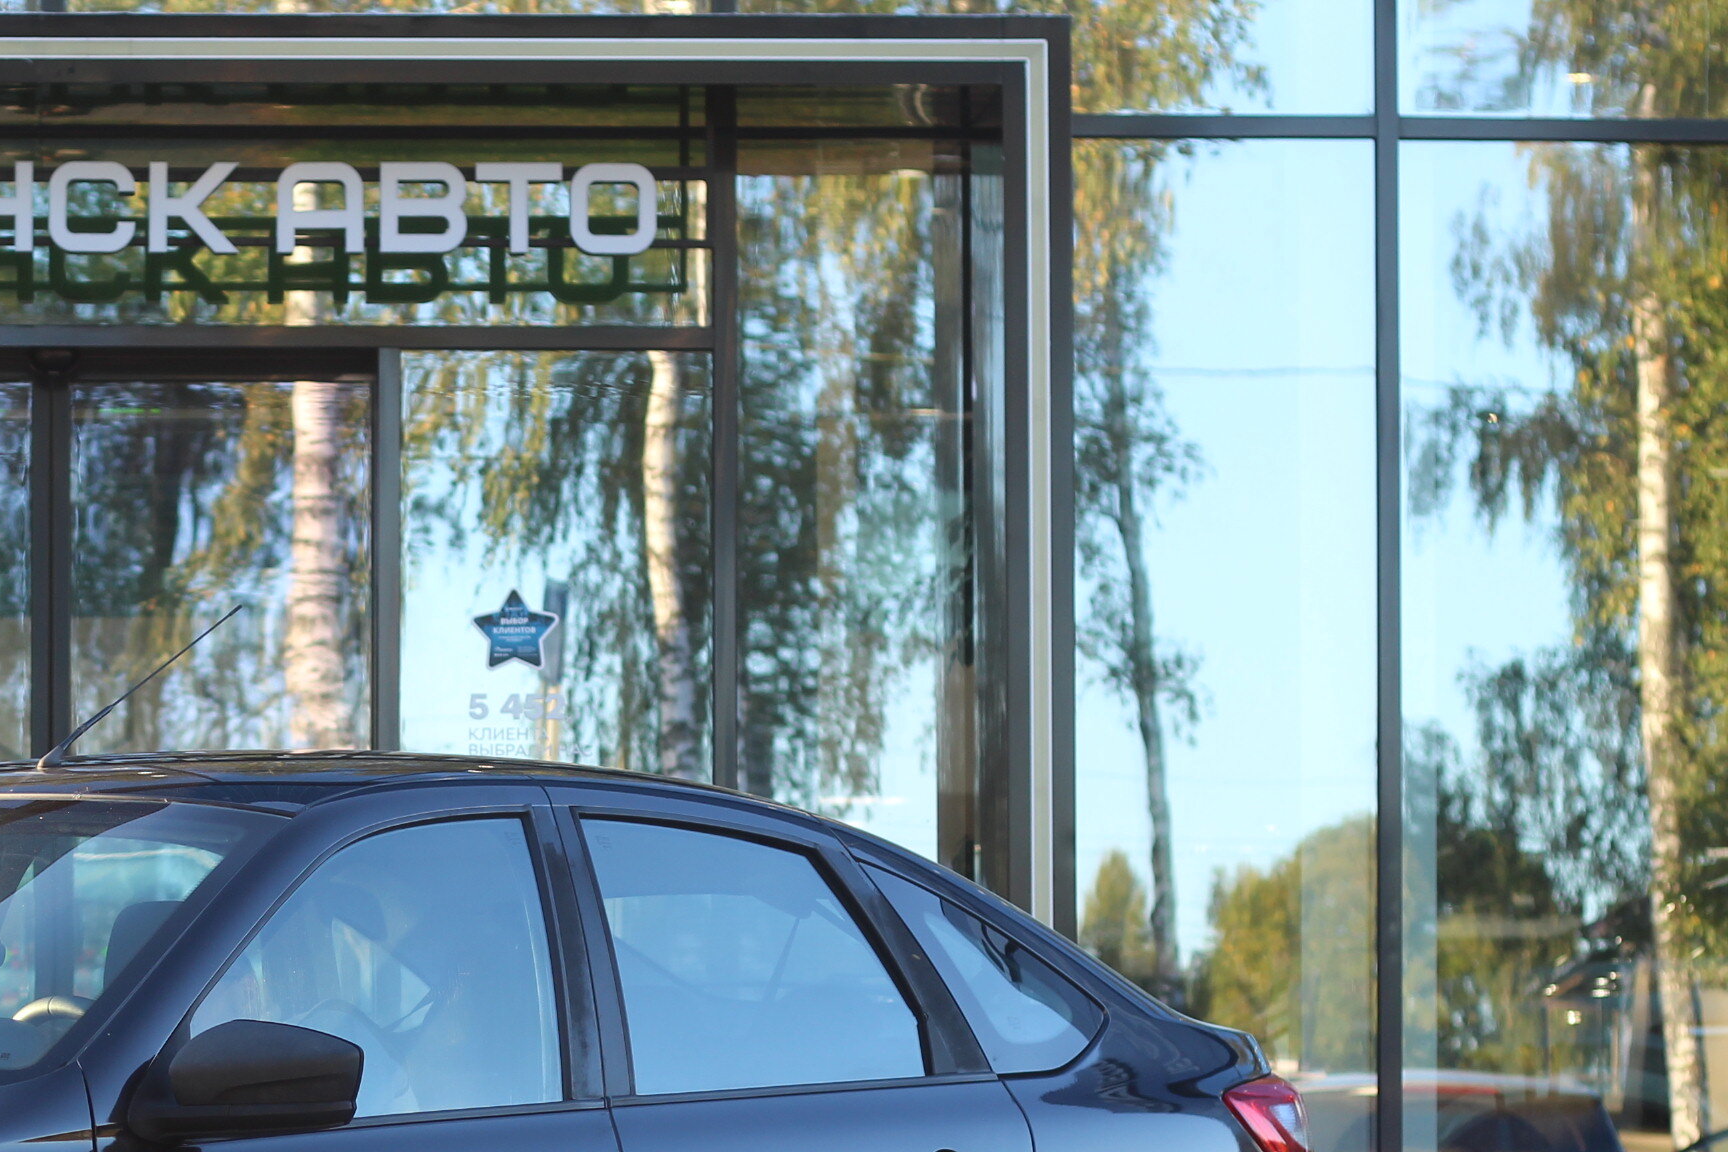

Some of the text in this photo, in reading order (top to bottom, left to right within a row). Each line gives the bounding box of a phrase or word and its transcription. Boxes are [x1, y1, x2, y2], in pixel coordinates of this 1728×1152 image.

[275, 161, 659, 256] АВТО
[500, 617, 529, 625] ВЫБОР
[493, 626, 536, 634] КЛИЕНТОВ
[469, 693, 489, 720] 5
